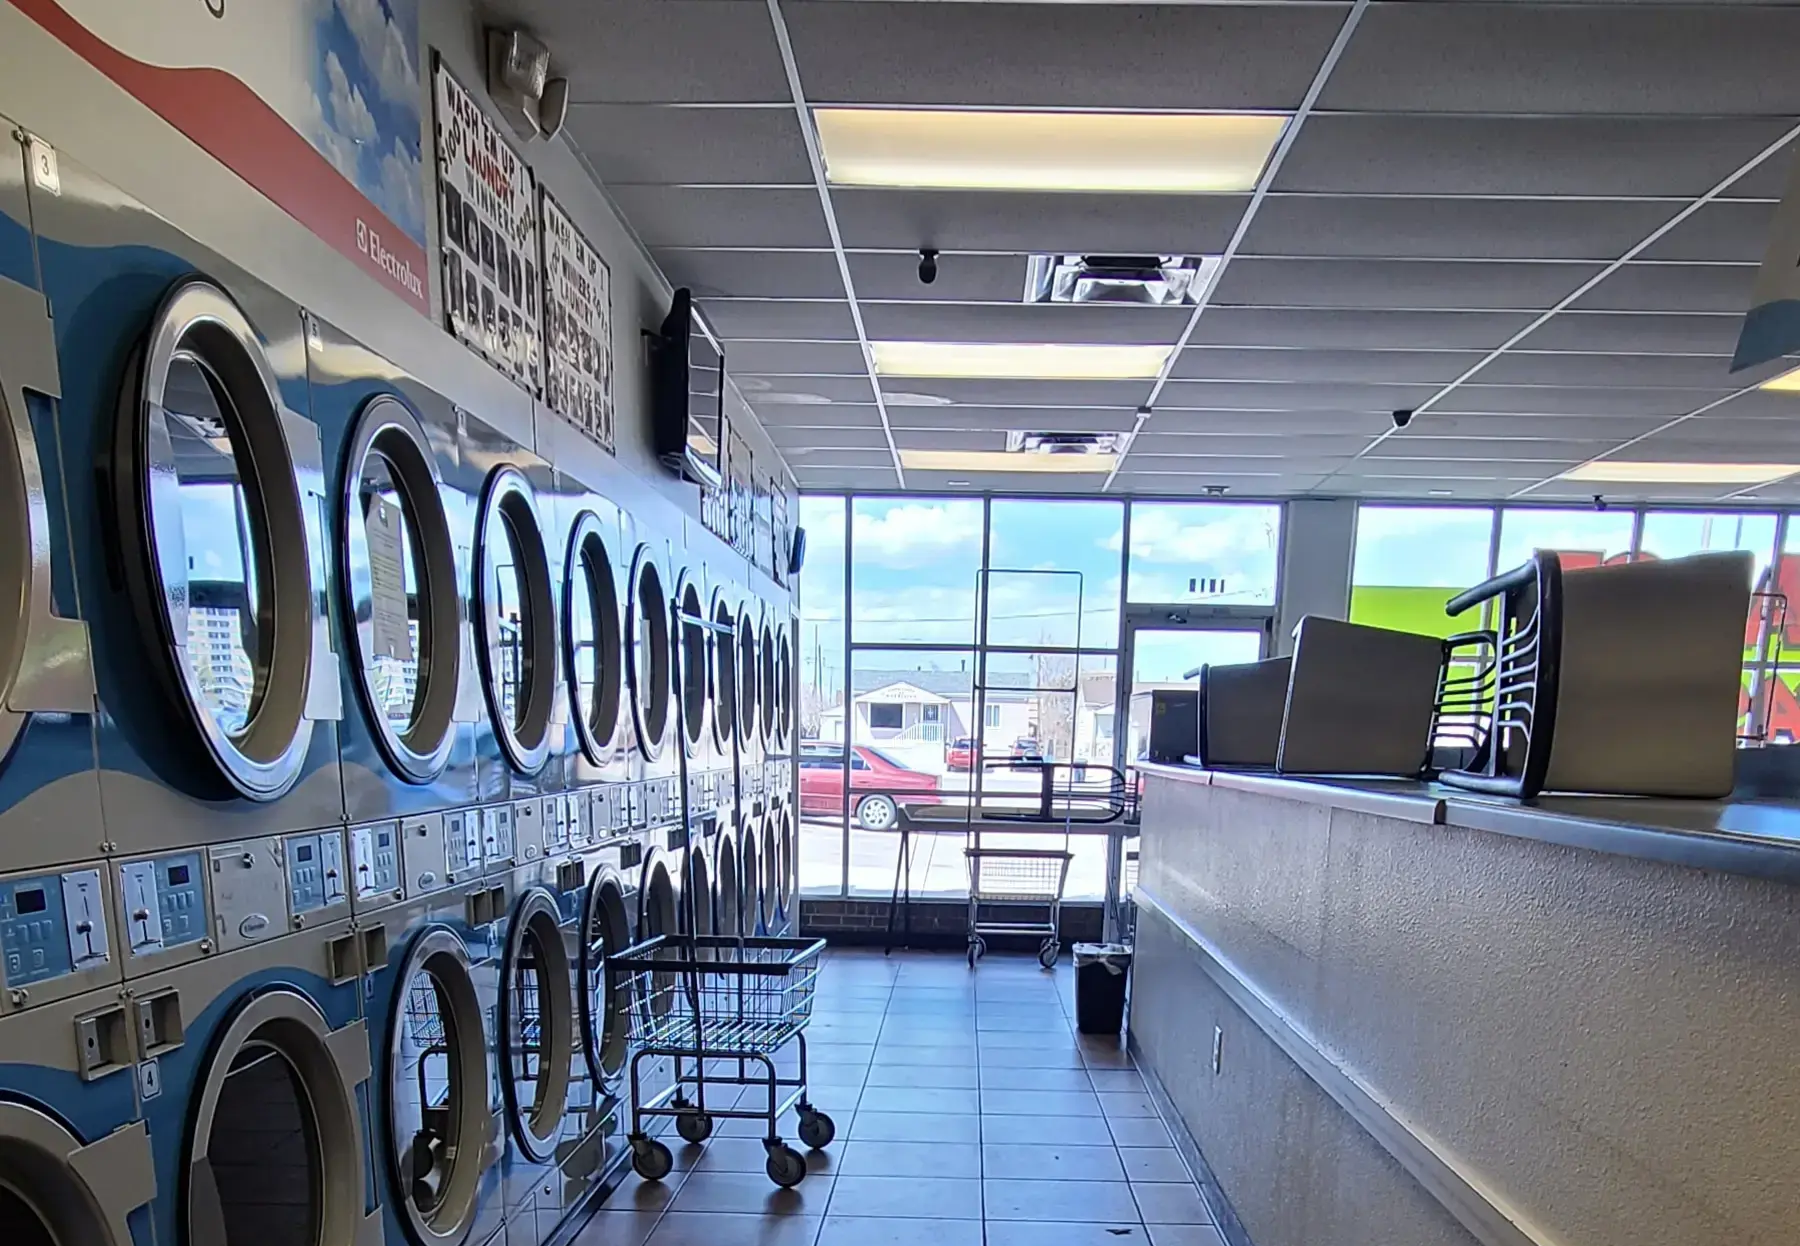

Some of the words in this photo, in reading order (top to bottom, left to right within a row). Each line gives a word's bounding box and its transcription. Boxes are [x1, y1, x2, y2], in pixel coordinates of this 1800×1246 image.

[446, 76, 479, 140] WASH
[501, 145, 515, 181] UP
[41, 154, 50, 177] 3
[462, 128, 516, 214] LAUNDRY
[465, 165, 517, 243] WINNERS
[369, 228, 424, 300] Electrolux
[548, 206, 571, 253] WASH
[587, 252, 597, 279] UP
[146, 1070, 154, 1088] 4
